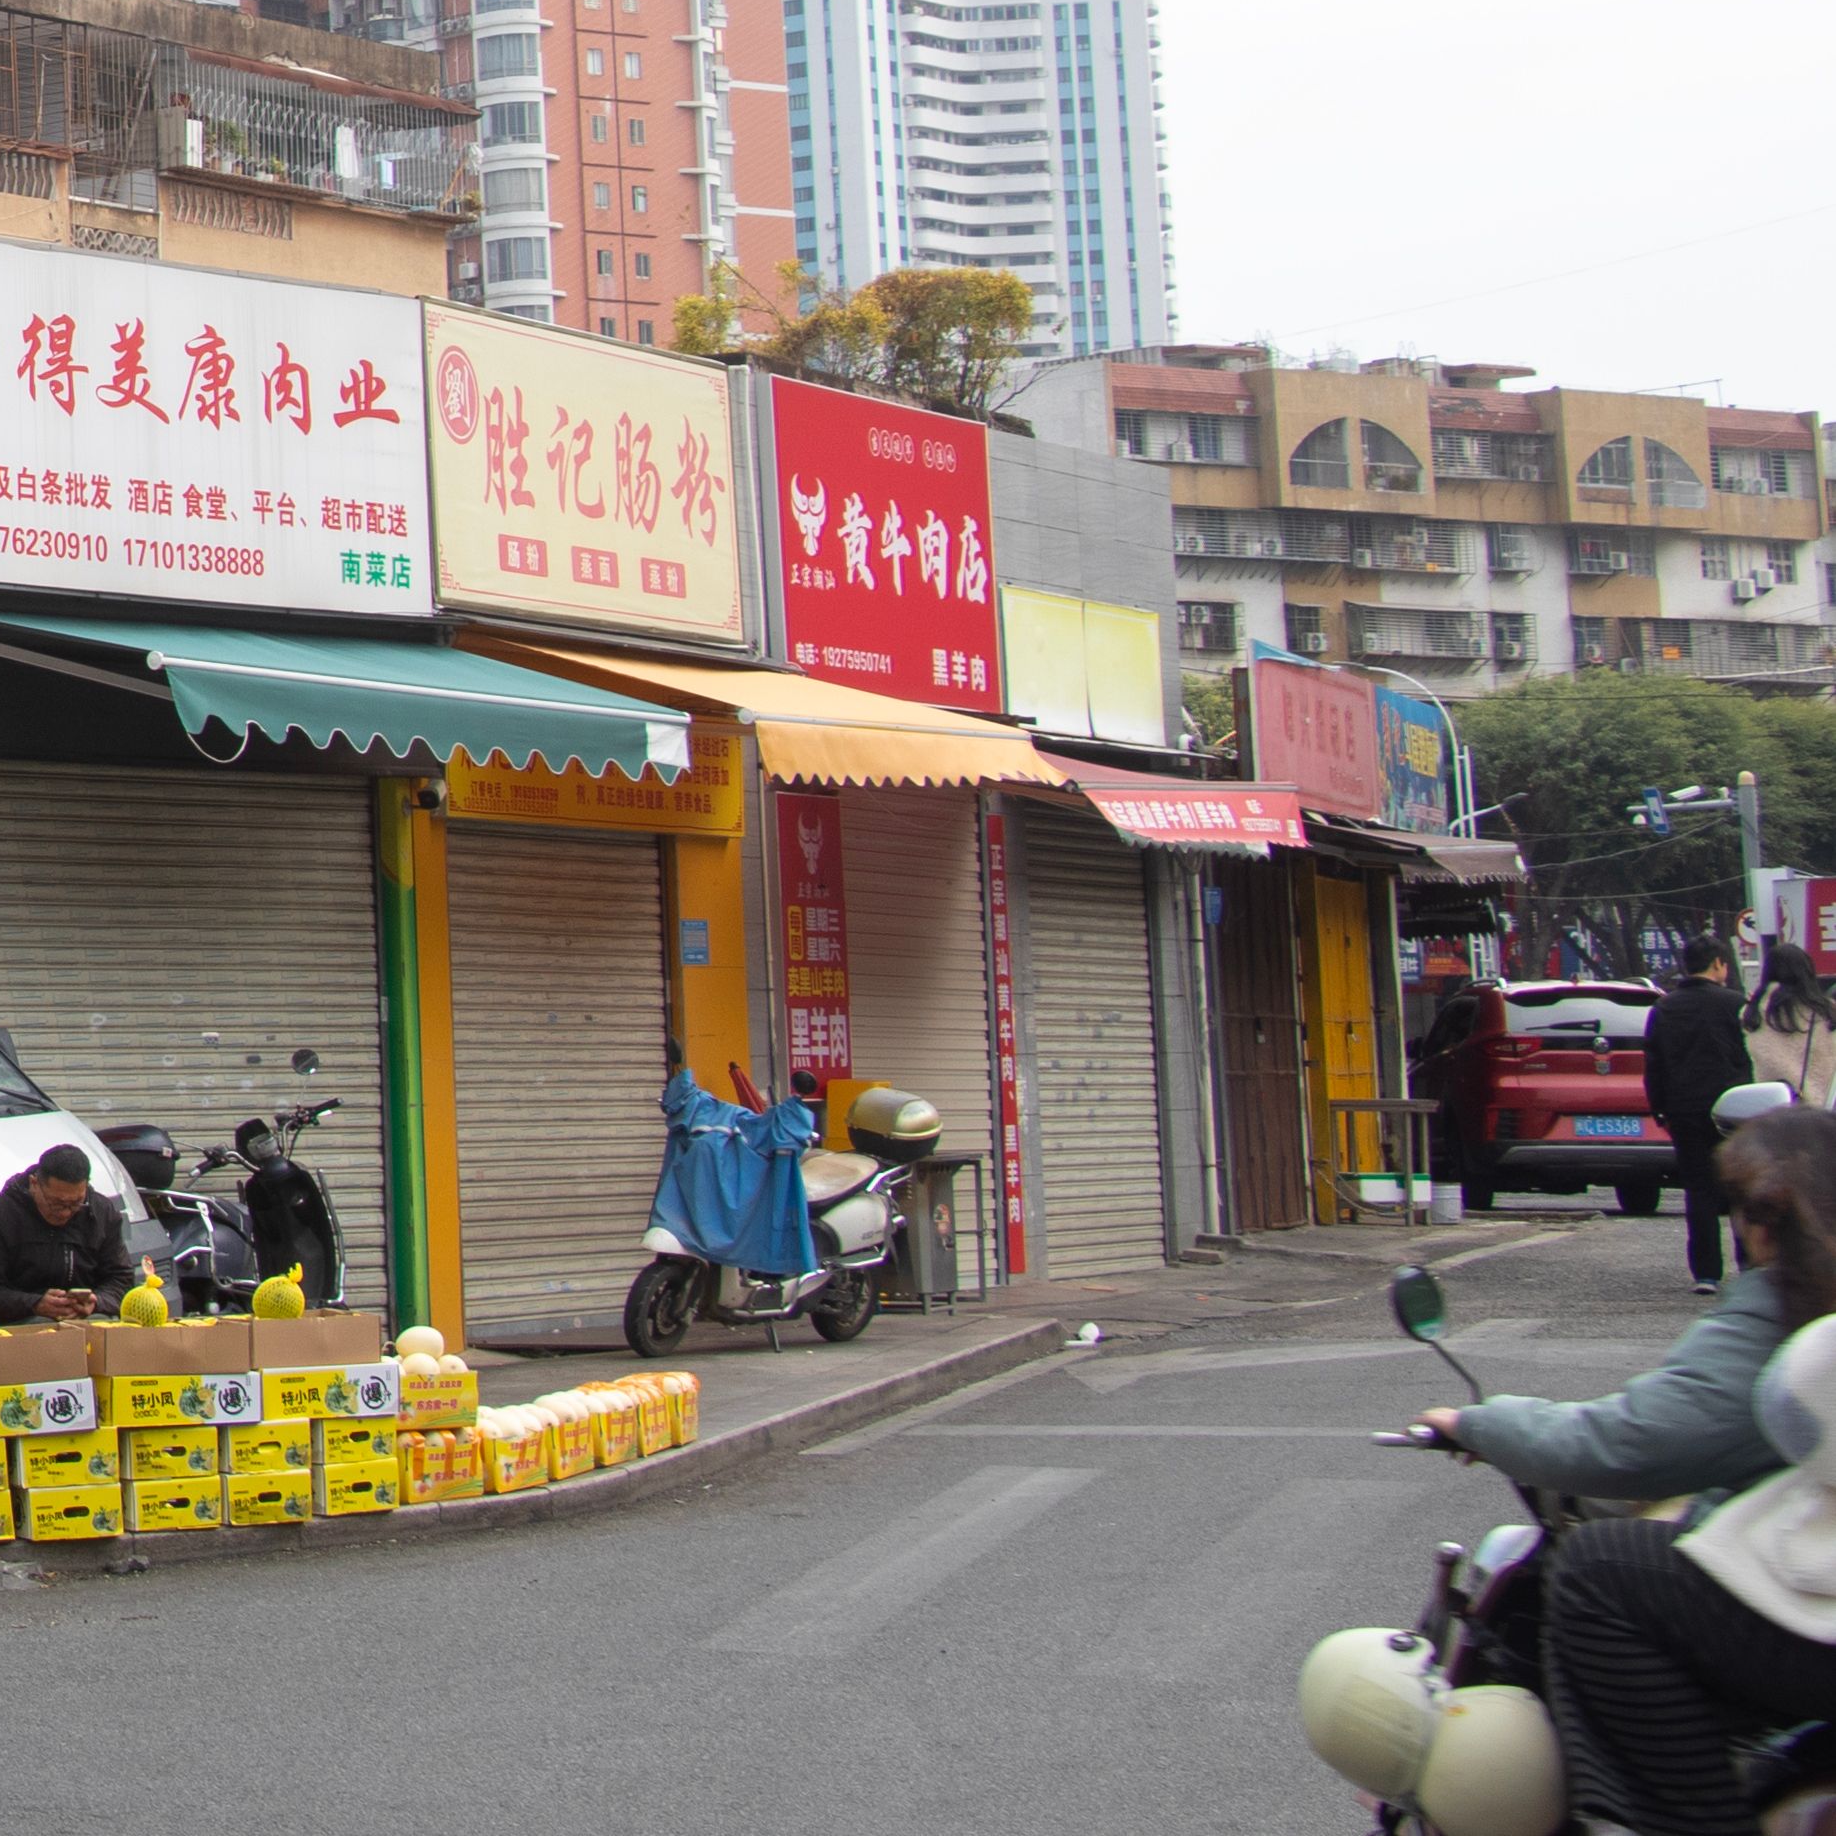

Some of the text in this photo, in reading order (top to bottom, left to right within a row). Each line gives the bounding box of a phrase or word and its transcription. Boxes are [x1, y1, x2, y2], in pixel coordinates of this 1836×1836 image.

[16, 312, 401, 436] 得美康肉业
[484, 386, 725, 548] 胜记肠粉
[122, 538, 265, 577] 17101338888
[507, 541, 539, 572] 肠粉
[837, 492, 987, 604] 黄牛肉店
[340, 551, 412, 590] 南菜店
[932, 649, 987, 691] 黑羊肉
[805, 907, 840, 932] 星期三
[807, 937, 841, 962] 星期六
[791, 1007, 848, 1069] 黑羊肉
[131, 1392, 175, 1408] 特小凤
[281, 1388, 321, 1405] 特小凤
